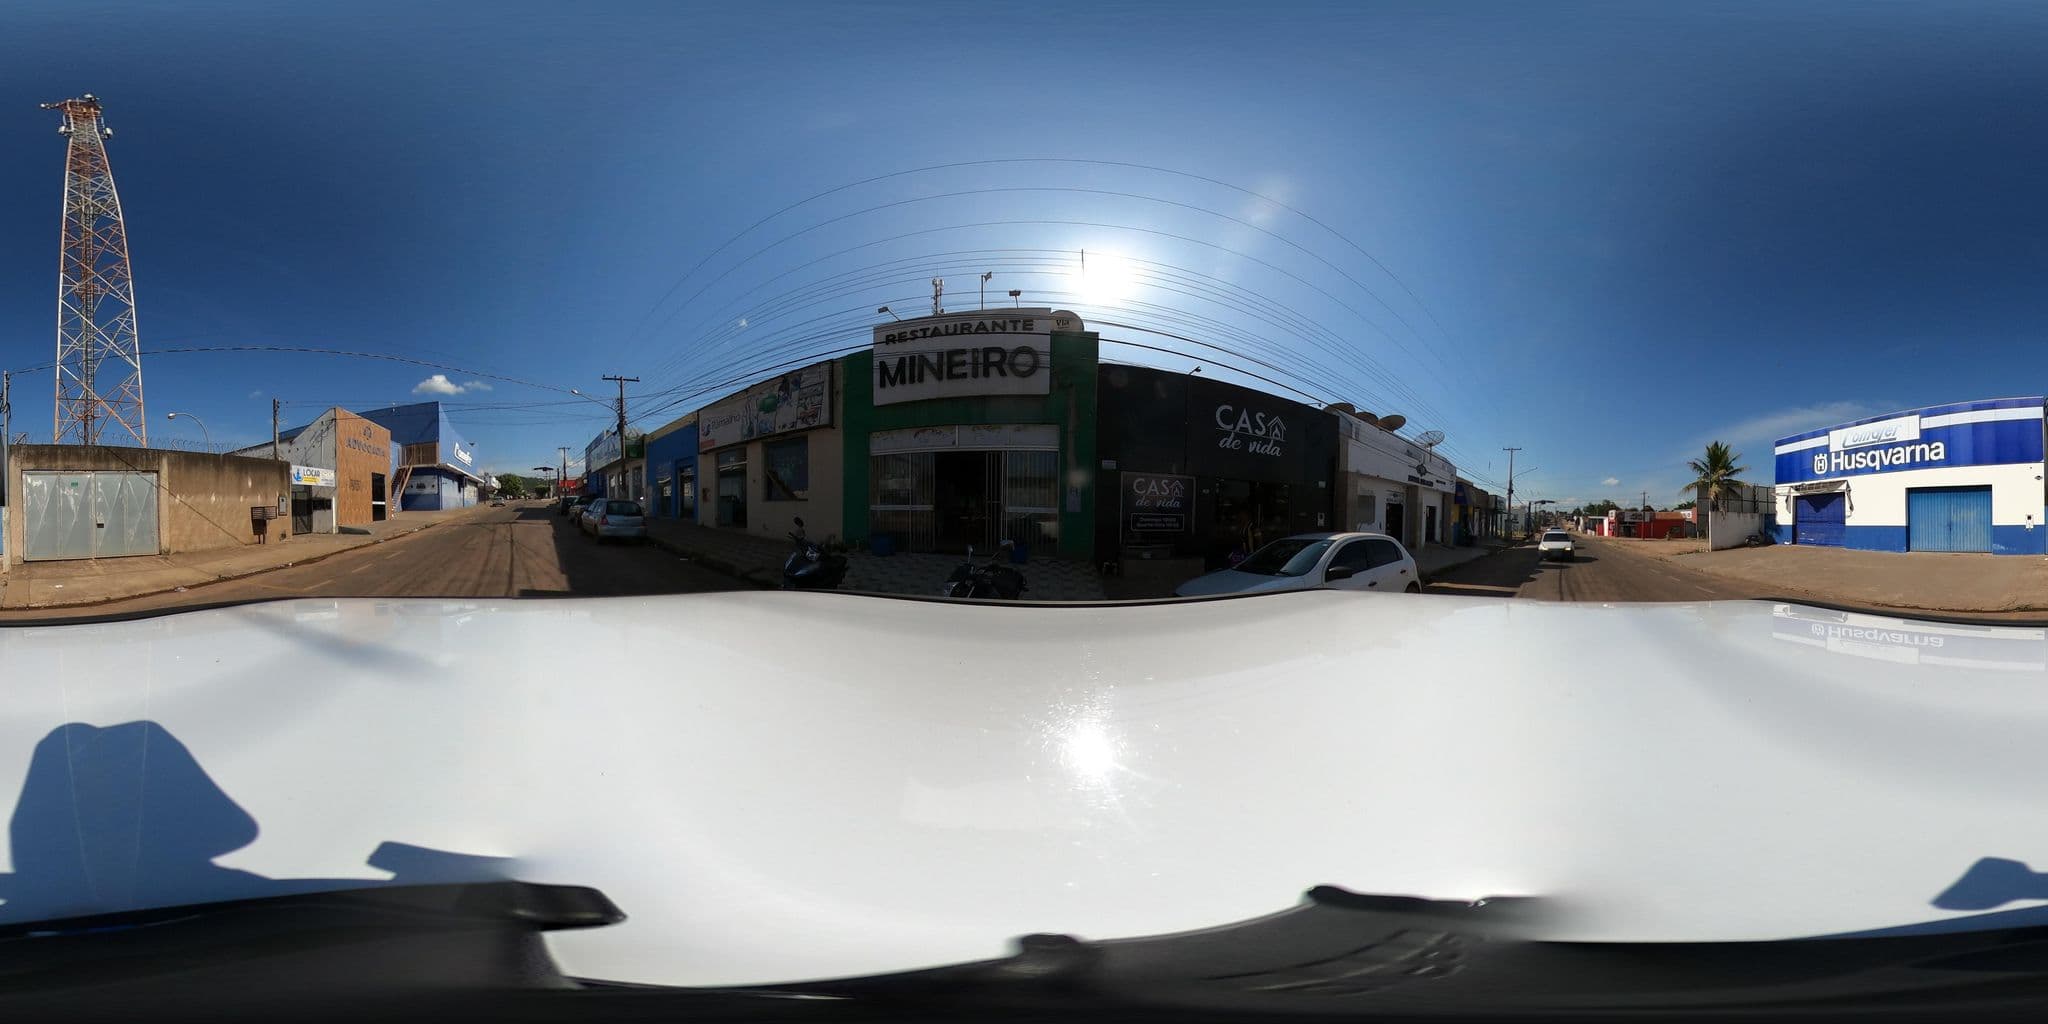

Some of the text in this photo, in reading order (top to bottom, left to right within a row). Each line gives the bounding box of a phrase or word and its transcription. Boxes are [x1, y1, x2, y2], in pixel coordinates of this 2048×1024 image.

[885, 319, 1034, 345] RESTAURANTE
[879, 346, 1040, 388] MINEIRO
[1218, 431, 1282, 456] de vida
[1831, 441, 1946, 472] Husqvarna
